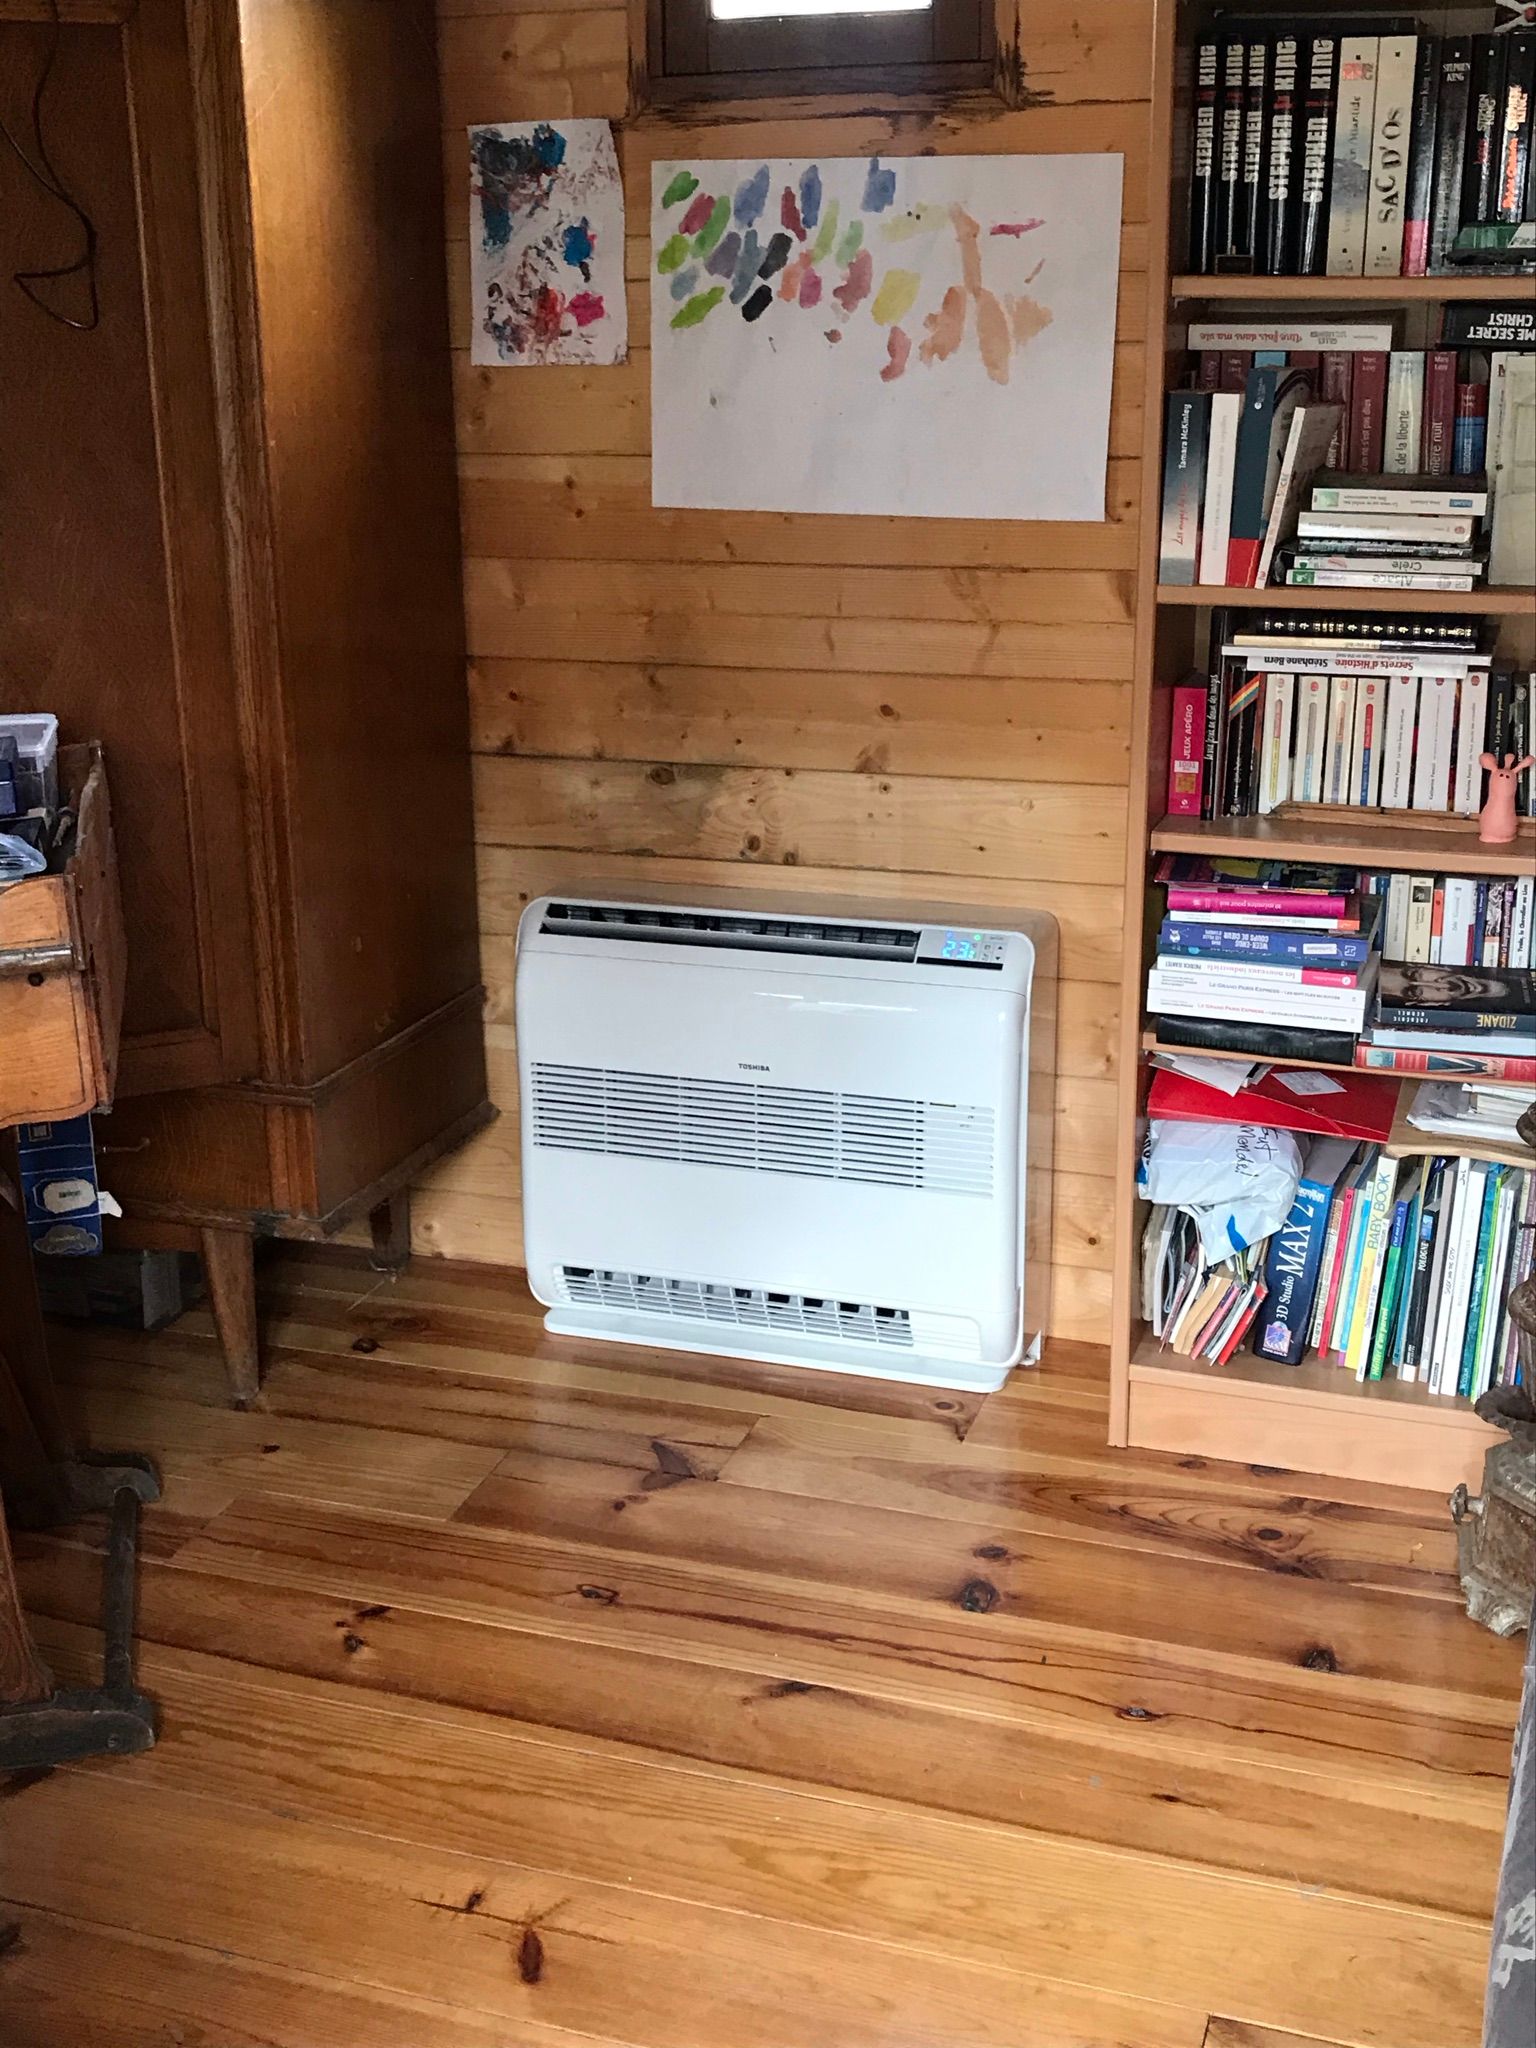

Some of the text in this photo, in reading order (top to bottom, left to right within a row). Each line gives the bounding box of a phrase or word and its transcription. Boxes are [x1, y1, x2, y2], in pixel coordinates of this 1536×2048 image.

[1196, 45, 1217, 176] STEPHEN KING
[1222, 44, 1244, 181] STEPHEN KING
[1244, 44, 1265, 182] STEPHEN KING
[1268, 41, 1297, 200] STEPHEN KING
[1302, 39, 1334, 202] STEPHEN KING
[1375, 176, 1399, 224] SAC
[1487, 313, 1534, 327] CHRIST
[1235, 333, 1257, 343] dans
[1467, 326, 1515, 340] SECRET
[1178, 403, 1192, 469] Tamara McKinley
[1431, 422, 1443, 442] nuit
[1396, 453, 1407, 465] de
[1391, 561, 1423, 572] Crète
[1372, 574, 1415, 587] Alsace
[1264, 656, 1285, 666] Bern
[1285, 656, 1329, 668] Stéphane
[1335, 658, 1379, 671] d'Histoire
[1380, 660, 1414, 671] Secrets
[1183, 704, 1193, 760] JEUX APÉRO
[1519, 904, 1527, 928] Chevalier
[1250, 934, 1269, 943] COUPS
[1476, 1014, 1517, 1029] ZIDANE
[738, 1063, 770, 1072] TOSHIBA
[1367, 1172, 1391, 1250] BABY BOOK
[1276, 1220, 1312, 1278] MAX
[1417, 1241, 1429, 1272] POLOGNE
[1278, 1275, 1295, 1304] Studio
[1276, 1305, 1289, 1321] 3D
